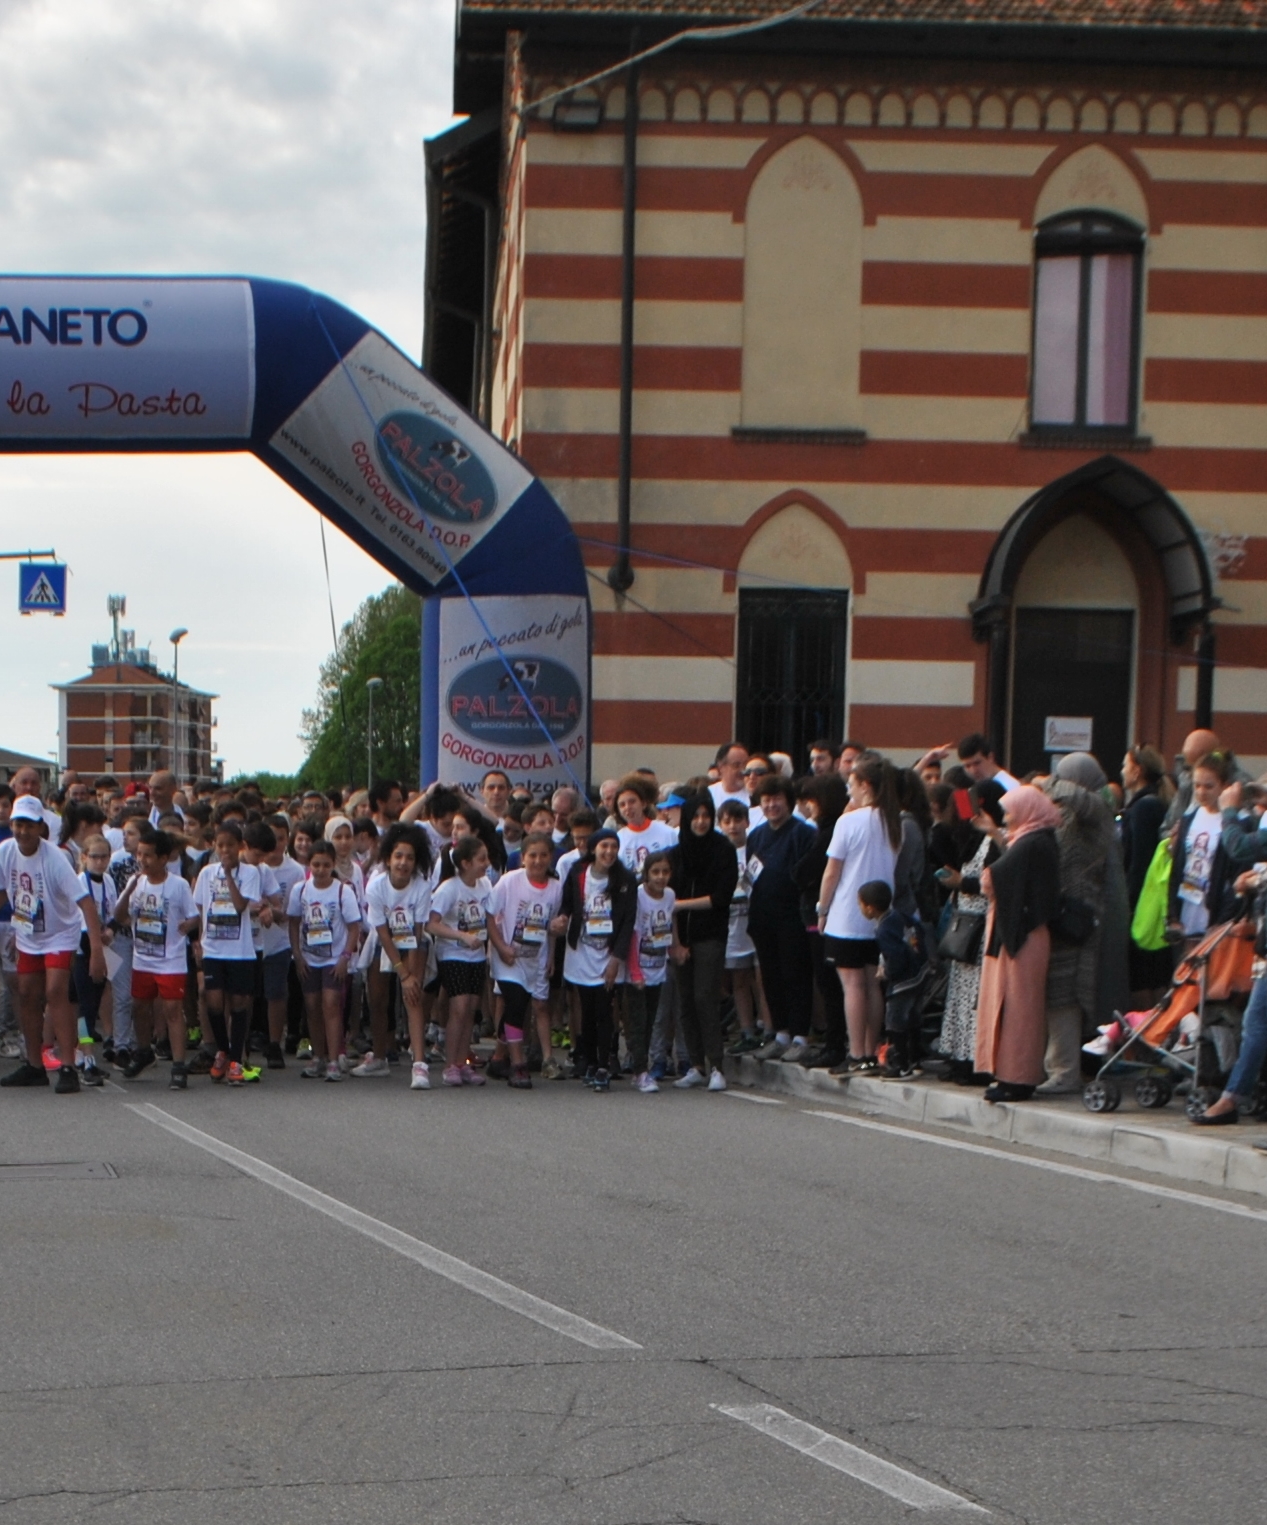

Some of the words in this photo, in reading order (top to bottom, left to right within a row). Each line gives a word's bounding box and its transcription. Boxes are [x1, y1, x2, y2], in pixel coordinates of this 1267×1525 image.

[7, 380, 51, 416] la
[68, 382, 207, 418] Pasta
[351, 440, 425, 534] GORGONZOLA
[380, 420, 484, 521] PALZOLA
[280, 428, 367, 507] www.palzola.it
[369, 505, 388, 527] Tel.
[388, 522, 448, 575] 0163.80940
[545, 611, 562, 635] di
[451, 695, 579, 720] PALZOLA
[442, 733, 554, 771] GORGONZOLA
